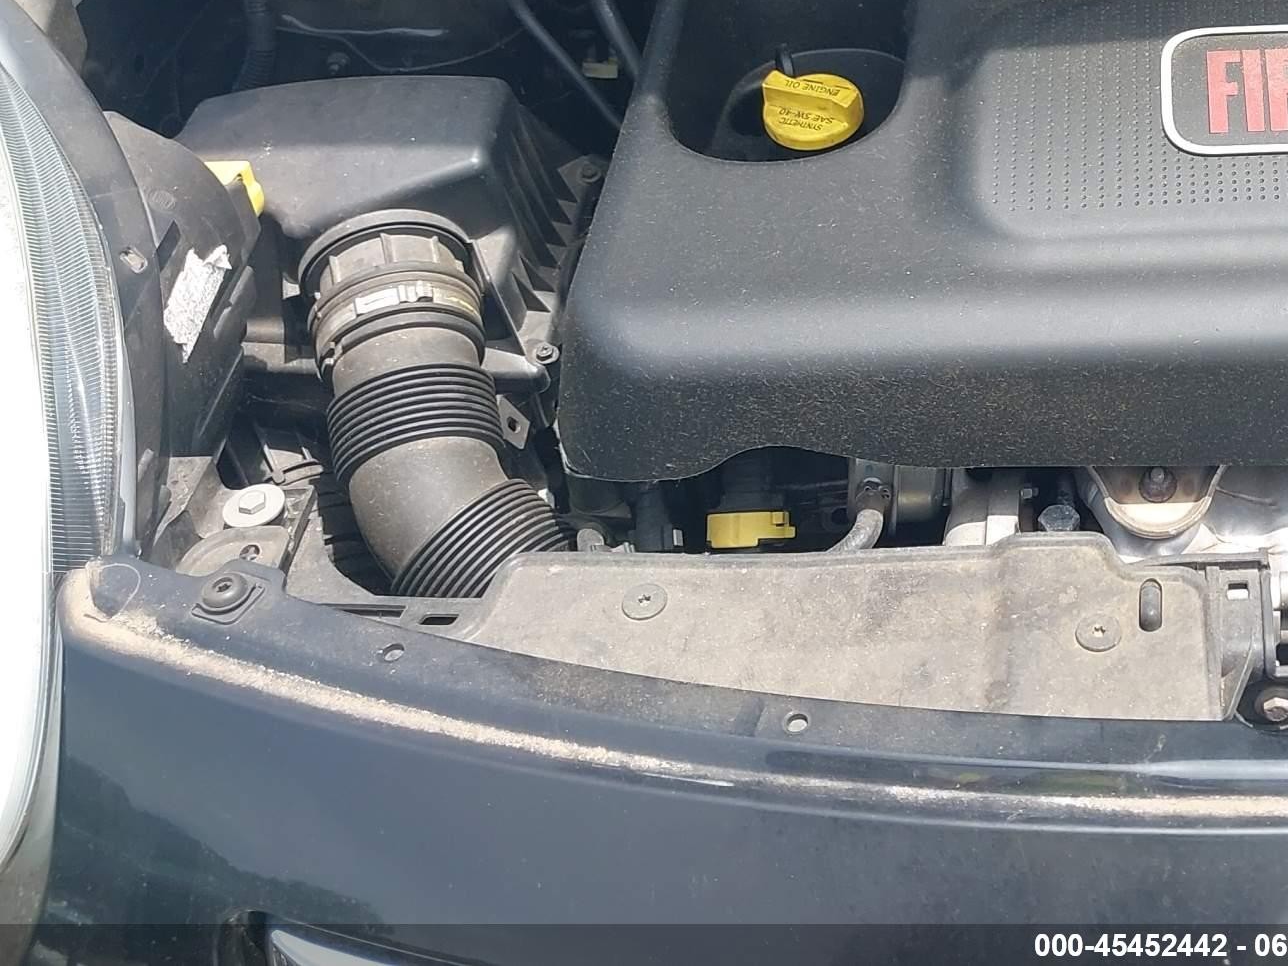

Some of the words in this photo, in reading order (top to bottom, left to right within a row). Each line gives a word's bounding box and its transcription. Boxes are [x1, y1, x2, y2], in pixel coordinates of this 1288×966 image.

[785, 80, 801, 88] OIL
[802, 83, 841, 96] ENGINE
[779, 117, 823, 131] SYNTHETIC
[812, 114, 835, 124] SAE
